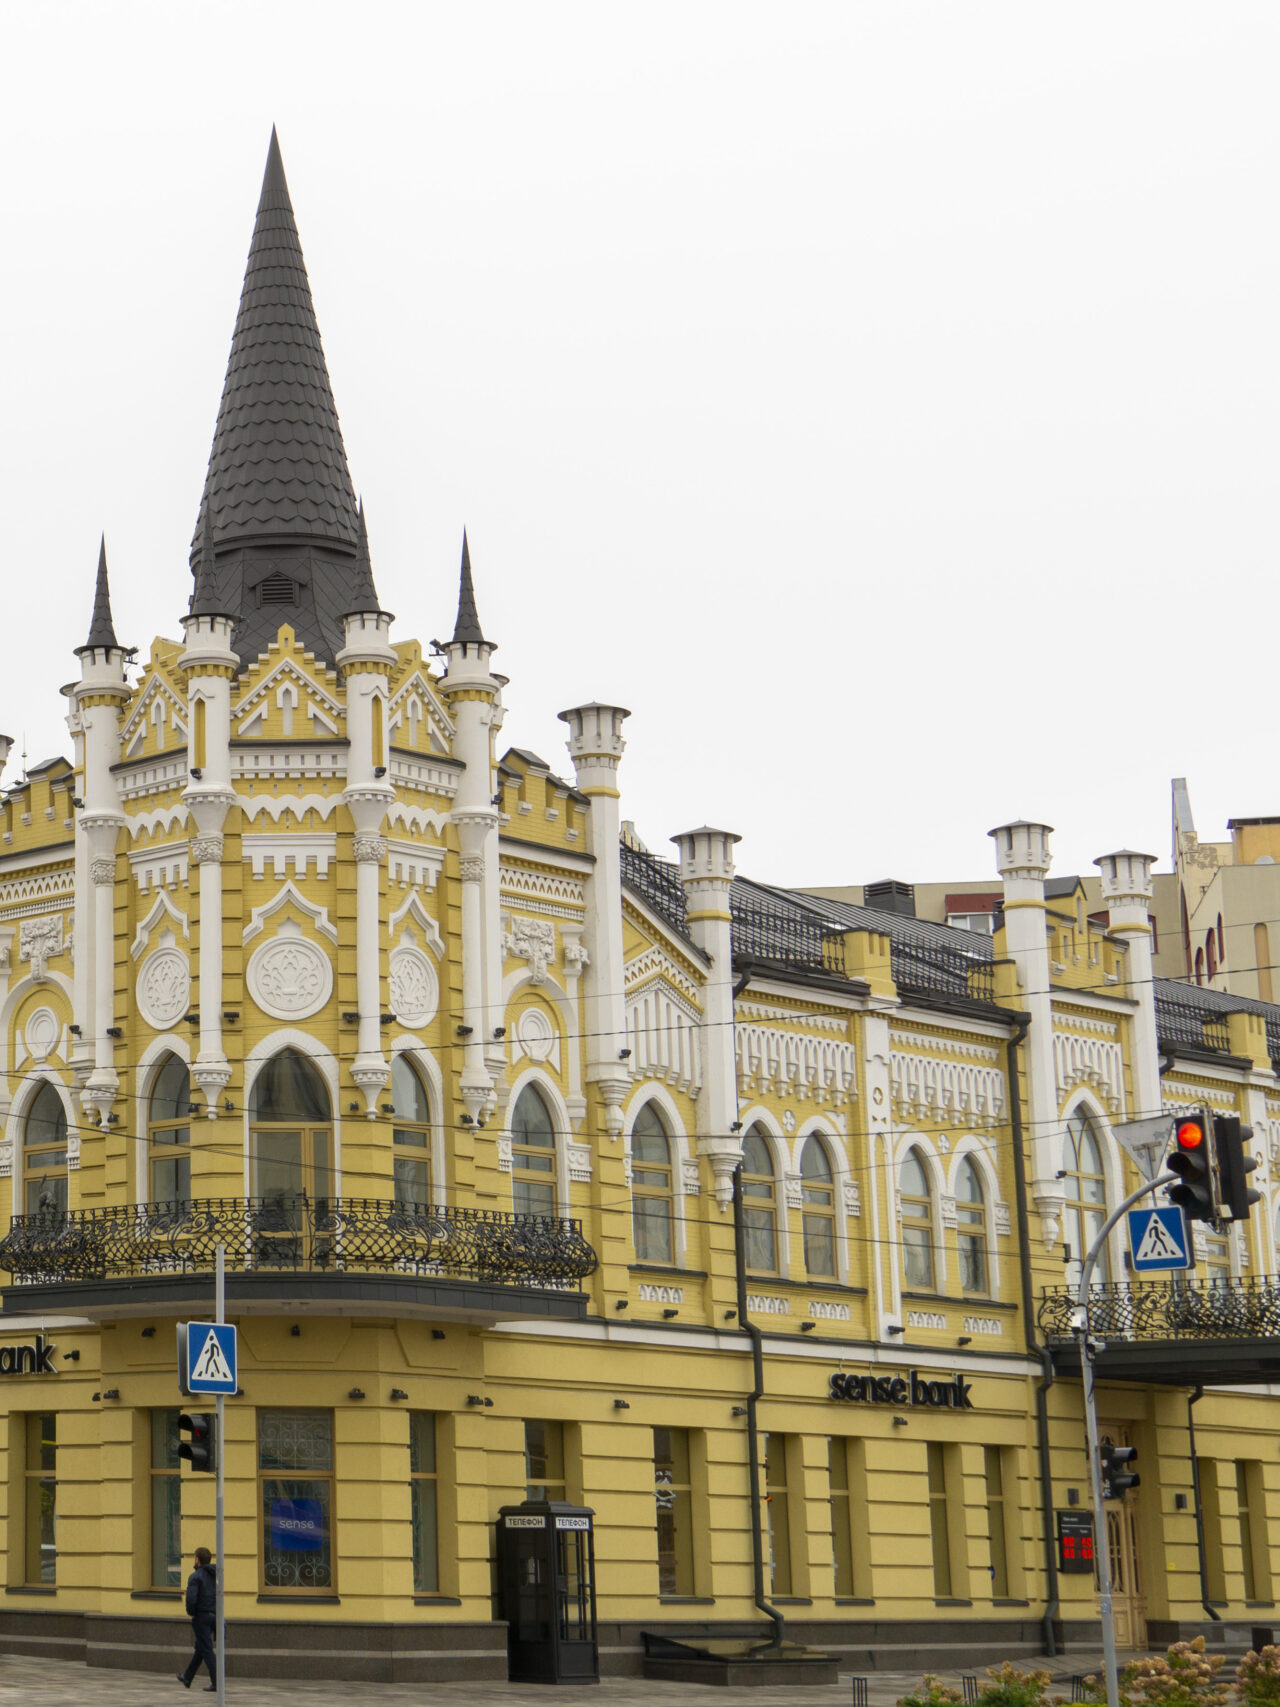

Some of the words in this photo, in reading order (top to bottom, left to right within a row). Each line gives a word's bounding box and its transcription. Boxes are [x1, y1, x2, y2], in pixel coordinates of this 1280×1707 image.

[829, 1373, 908, 1404] sense
[909, 1369, 974, 1409] bank
[279, 1520, 315, 1529] sense
[508, 1518, 543, 1526] ТЕЛЕФОН
[557, 1518, 587, 1527] ТЕЛЕФОН
